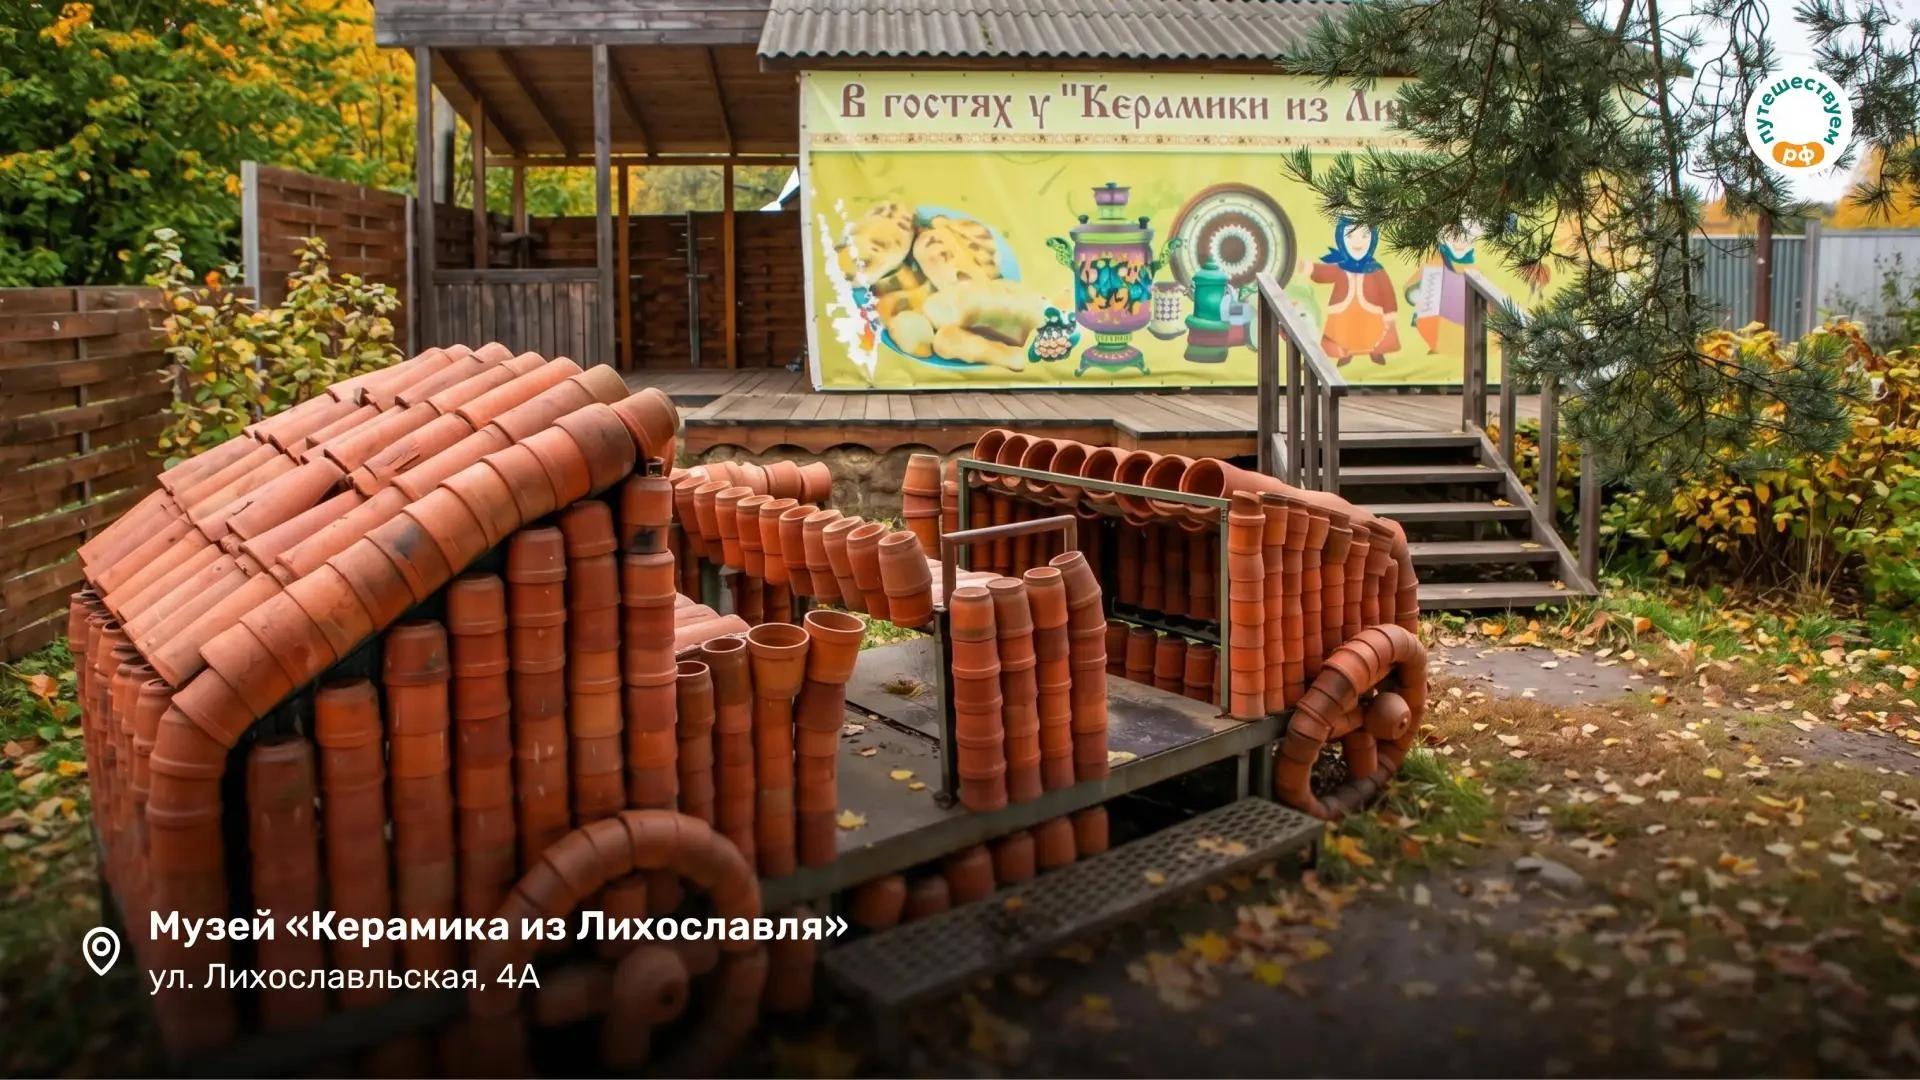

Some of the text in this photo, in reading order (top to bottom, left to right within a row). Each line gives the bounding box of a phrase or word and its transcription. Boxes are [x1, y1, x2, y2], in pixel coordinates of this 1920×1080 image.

[840, 83, 866, 118] В
[884, 94, 1013, 129] гостях
[1029, 95, 1051, 130] у
[1062, 84, 1269, 130] "Керамики
[1287, 97, 1329, 123] из
